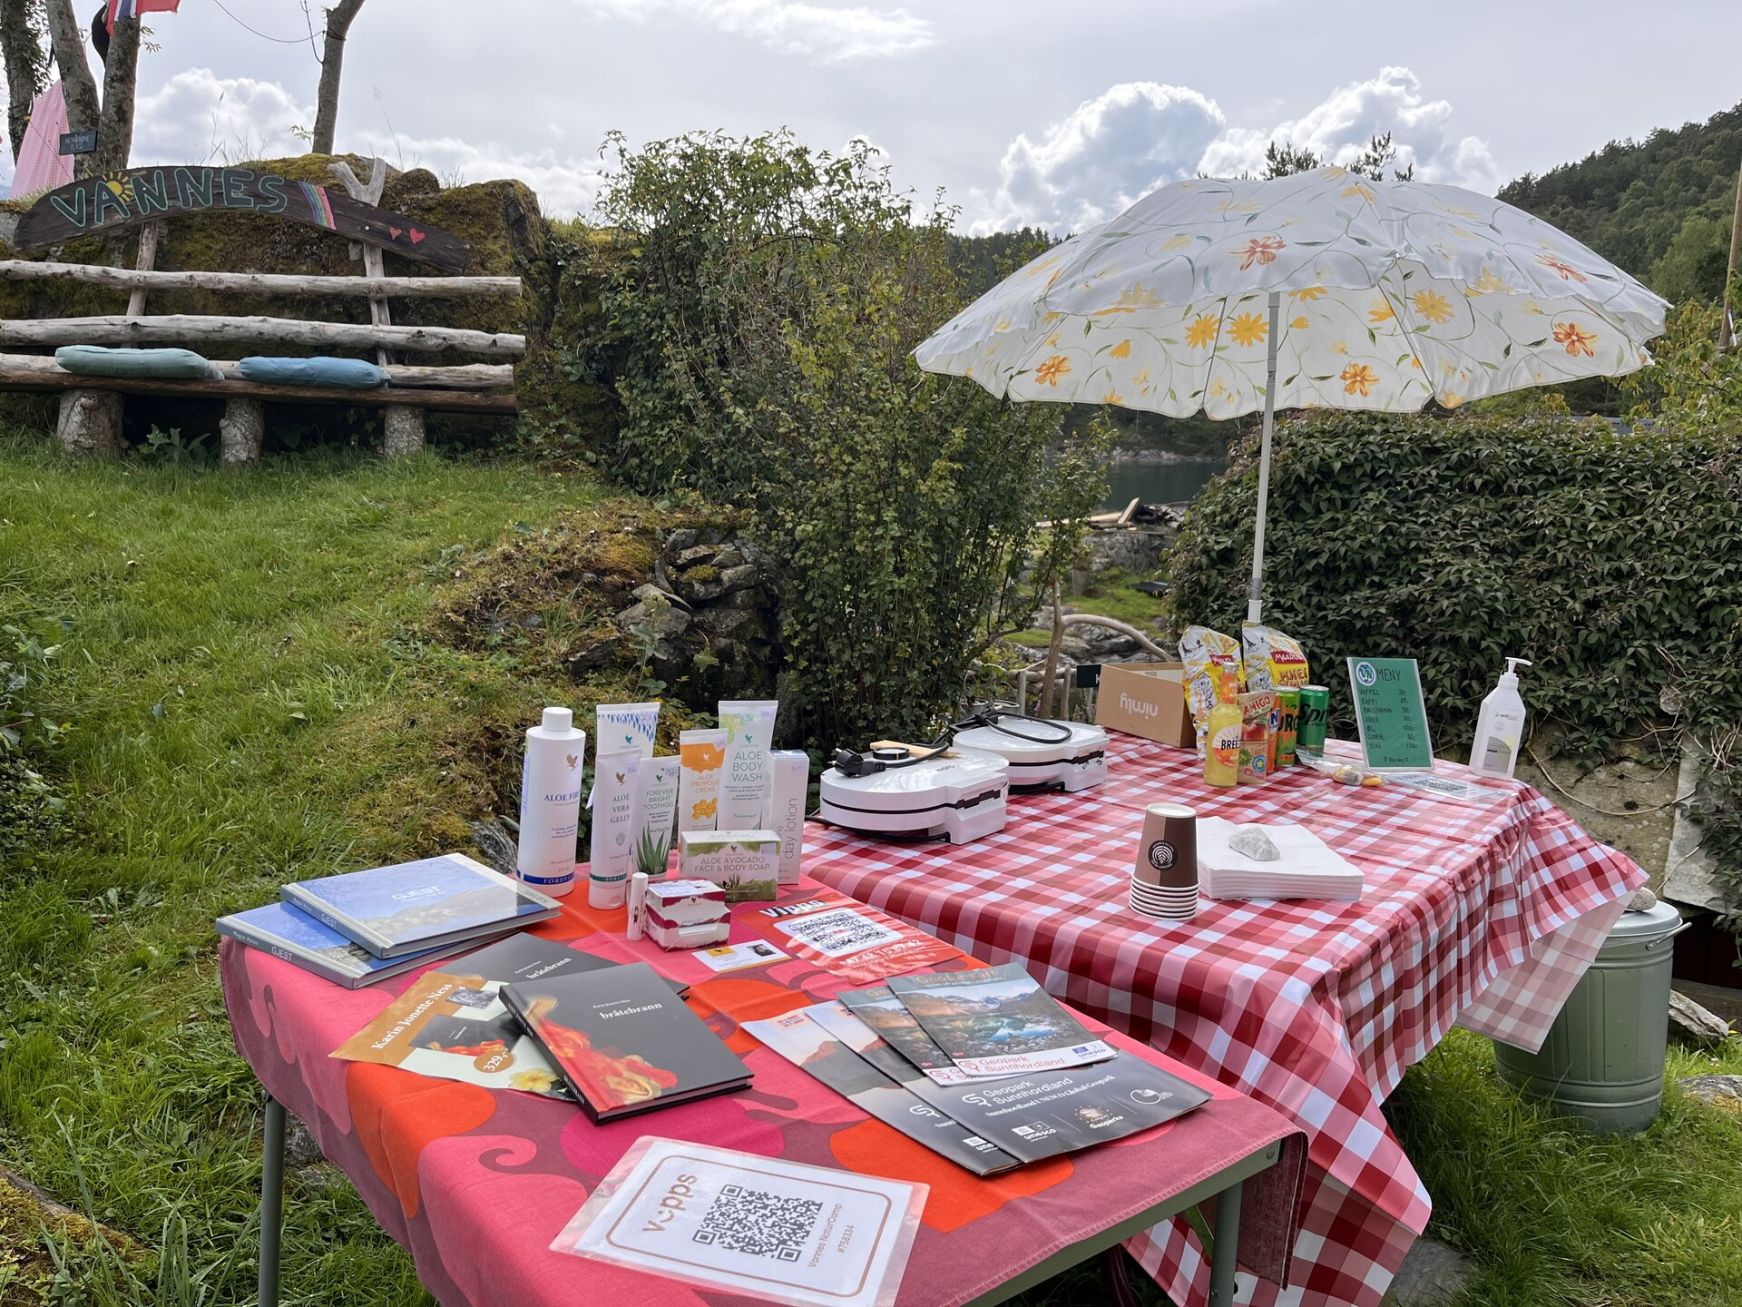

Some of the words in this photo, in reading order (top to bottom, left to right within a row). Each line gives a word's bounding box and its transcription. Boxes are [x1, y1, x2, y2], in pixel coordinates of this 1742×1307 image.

[51, 168, 288, 228] VANNES
[1376, 669, 1401, 682] MENY
[1120, 692, 1158, 719] nimly
[1243, 695, 1271, 715] AMIGO
[1221, 737, 1240, 750] BREE
[735, 751, 762, 760] ALOE
[732, 762, 764, 771] BODY
[732, 773, 763, 782] WASH
[544, 793, 567, 801] ALOE
[613, 794, 629, 802] ALOE
[646, 789, 673, 797] FOREVER
[612, 805, 629, 813] VERA
[784, 798, 798, 832] lotion
[784, 836, 797, 859] day
[760, 900, 825, 918] Vipps
[321, 913, 337, 929] GJEST
[271, 946, 293, 961] GJEST
[371, 1024, 401, 1050] Karin
[400, 998, 434, 1033] Jonette
[427, 983, 453, 1002] Ness
[600, 1002, 663, 1020] bråtebrann
[979, 1055, 1028, 1066] Geopark
[985, 1058, 1066, 1072] Sunnhordland
[983, 1080, 1034, 1097] Geopark
[993, 1077, 1074, 1105] Sunnhordland
[1089, 1115, 1124, 1129] Geoparks
[1023, 1128, 1057, 1140] unesco
[808, 1242, 826, 1267] Vannes
[819, 1203, 842, 1242] NaturCamp
